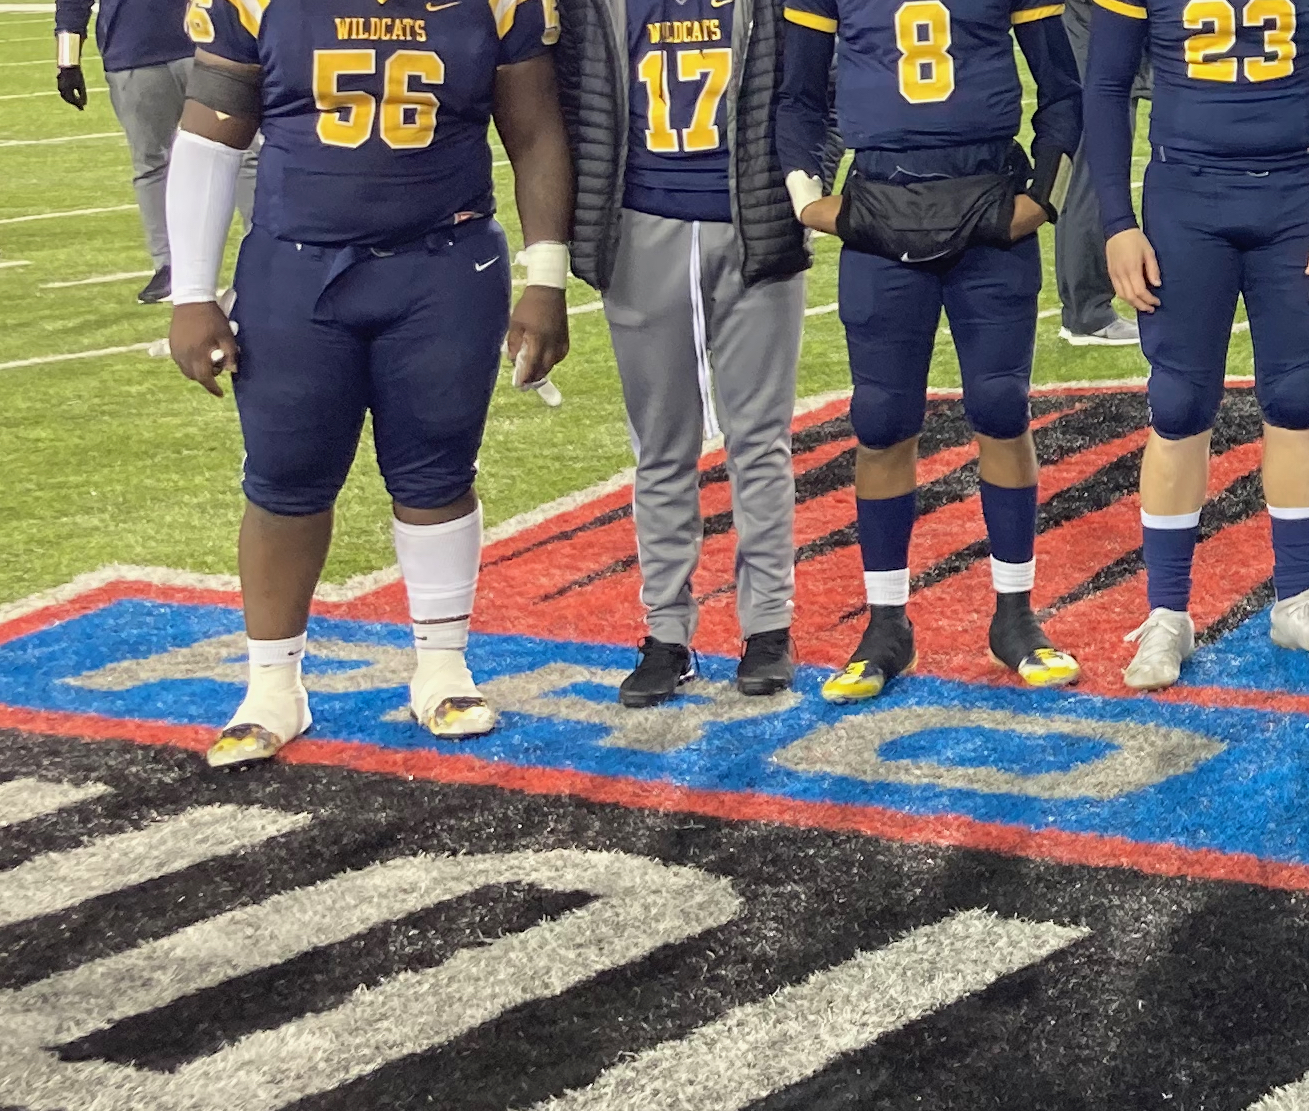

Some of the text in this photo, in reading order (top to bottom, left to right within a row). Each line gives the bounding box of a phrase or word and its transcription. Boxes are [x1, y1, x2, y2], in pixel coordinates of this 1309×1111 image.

[335, 17, 427, 42] WILDCATS
[646, 19, 722, 44] WILDCATS
[894, 0, 955, 103] 8
[313, 49, 445, 149] 56
[637, 48, 732, 152] 17
